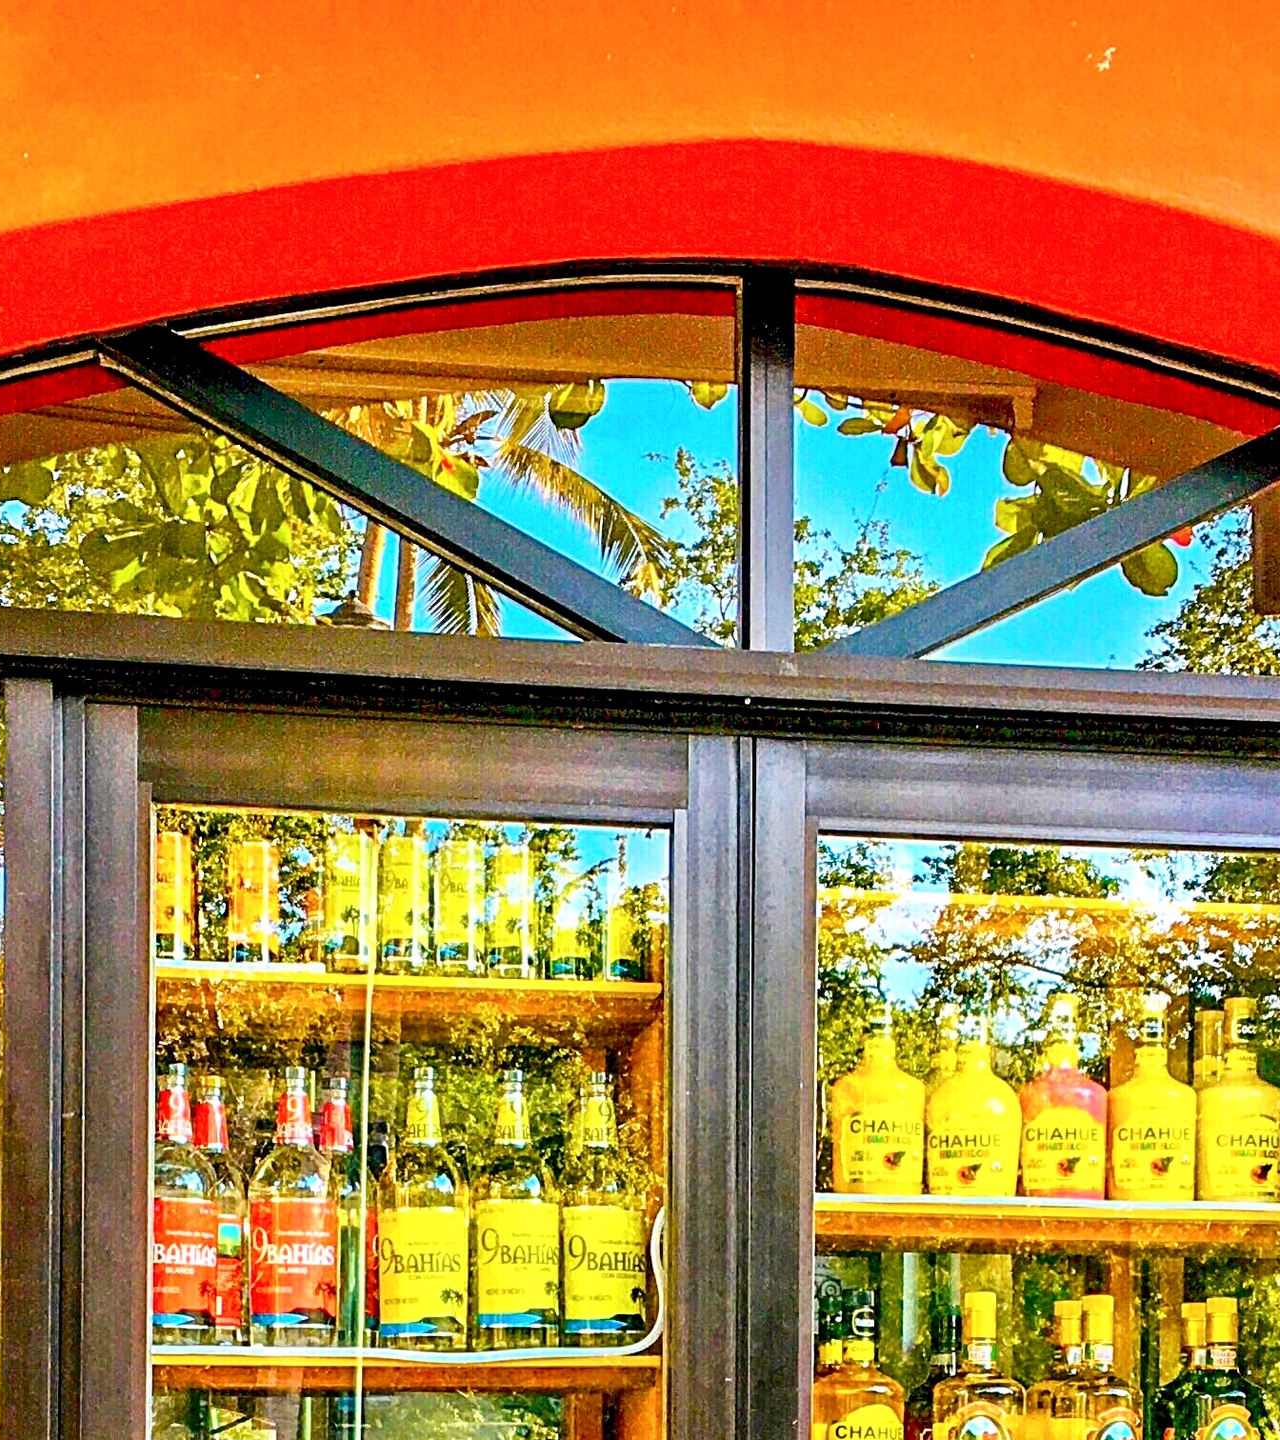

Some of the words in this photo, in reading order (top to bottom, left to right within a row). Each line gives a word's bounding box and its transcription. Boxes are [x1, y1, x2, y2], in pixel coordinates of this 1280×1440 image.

[169, 1091, 185, 1115] 9
[286, 1095, 303, 1118] 9
[598, 1101, 613, 1124] 9
[929, 1133, 1002, 1149] CHAHUE
[1025, 1127, 1098, 1142] CHAHUE
[1117, 1127, 1191, 1142] CHAHUE
[834, 1424, 903, 1440] CHAHUE
